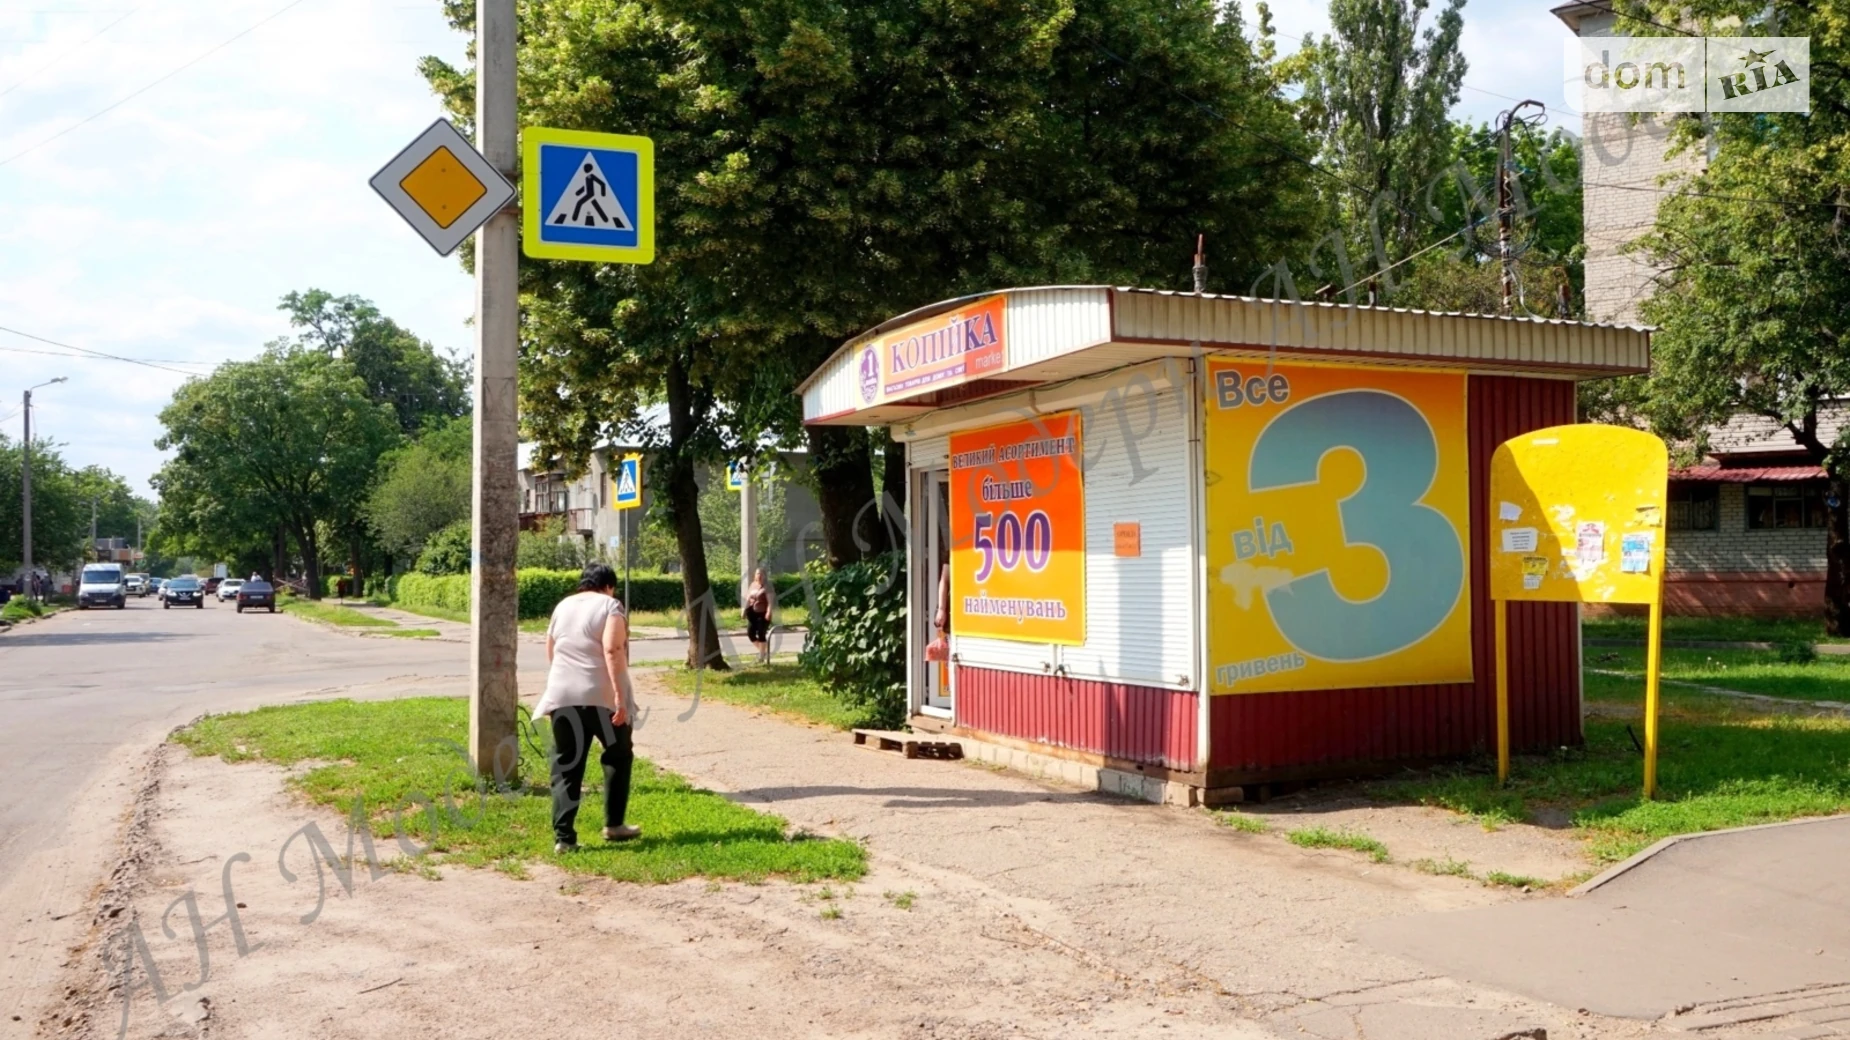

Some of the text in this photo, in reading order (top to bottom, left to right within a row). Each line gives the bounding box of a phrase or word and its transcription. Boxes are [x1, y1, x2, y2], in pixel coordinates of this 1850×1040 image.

[891, 312, 997, 373] КОПІЙКА
[1216, 369, 1290, 409] Все
[952, 436, 1076, 469] ВЕЛИКИЙ АСОРТИМЕНТ
[982, 474, 1033, 501] більше
[974, 509, 1052, 582] 500
[1232, 516, 1294, 560] від
[1249, 388, 1465, 663] 3
[964, 590, 1066, 623] найменувань
[1216, 650, 1306, 686] гривень
